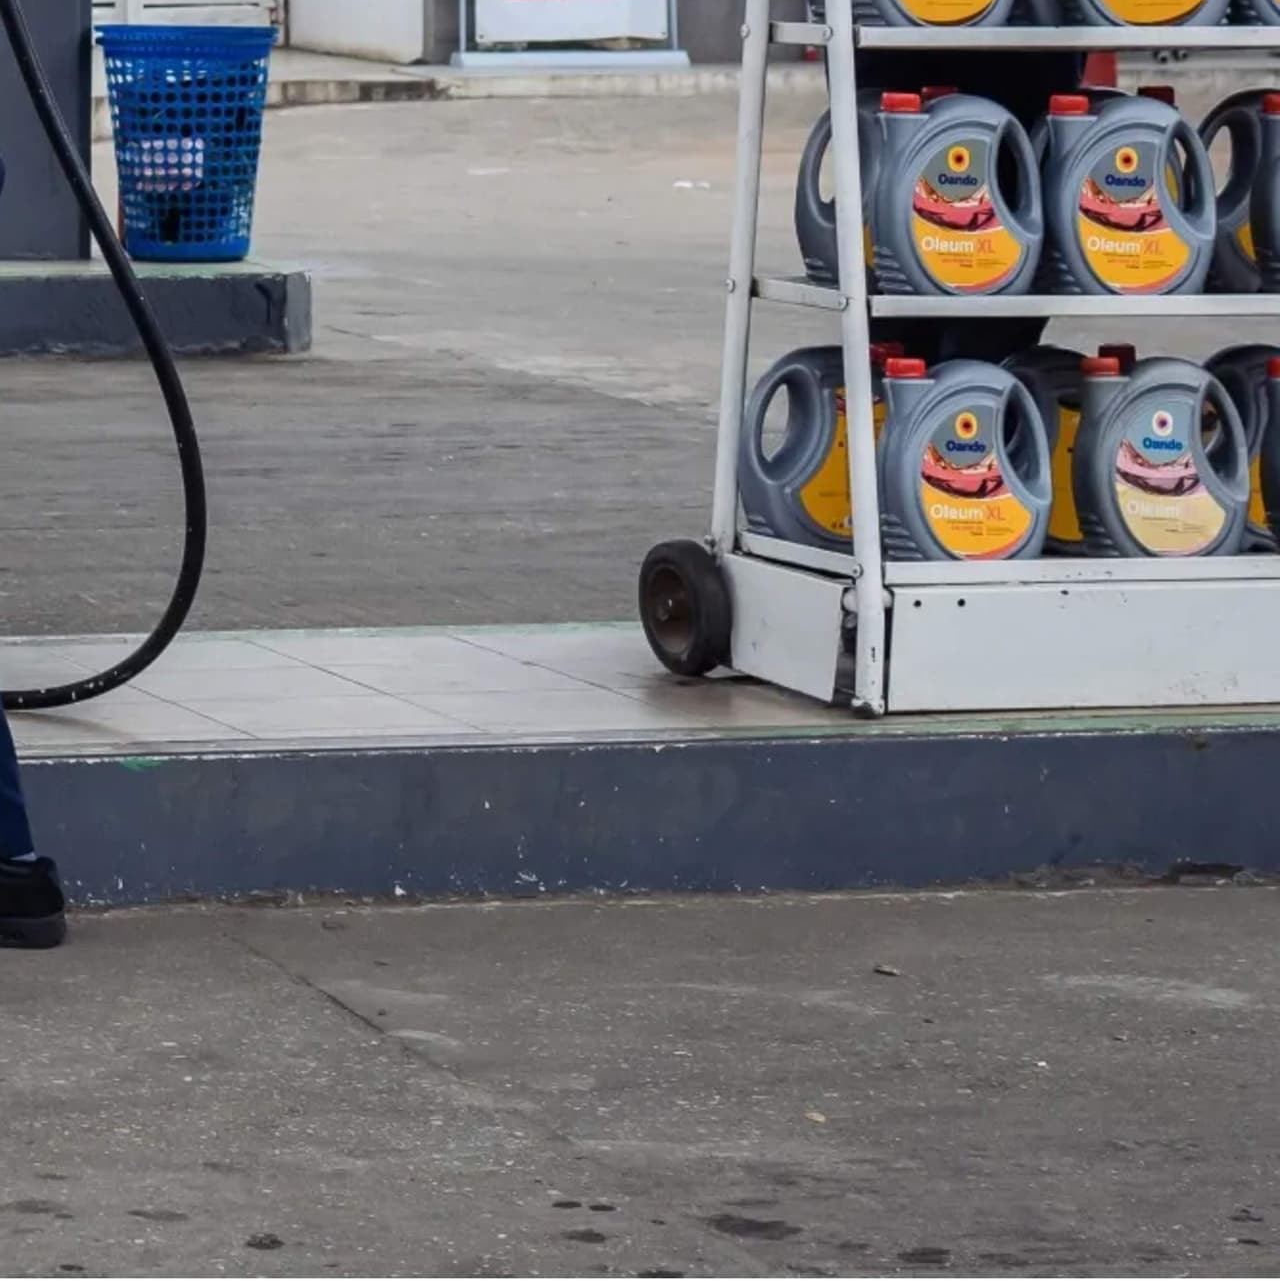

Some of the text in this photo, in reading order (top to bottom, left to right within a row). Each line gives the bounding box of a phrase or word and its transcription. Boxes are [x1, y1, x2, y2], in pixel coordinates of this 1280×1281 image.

[937, 173, 978, 186] Oando
[1104, 174, 1146, 187] Oando
[921, 235, 996, 254] Oleum XL
[1087, 235, 1141, 254] Oleum
[945, 439, 986, 453] Oando
[1142, 436, 1183, 450] Oando
[929, 503, 1006, 521] Oleum XL
